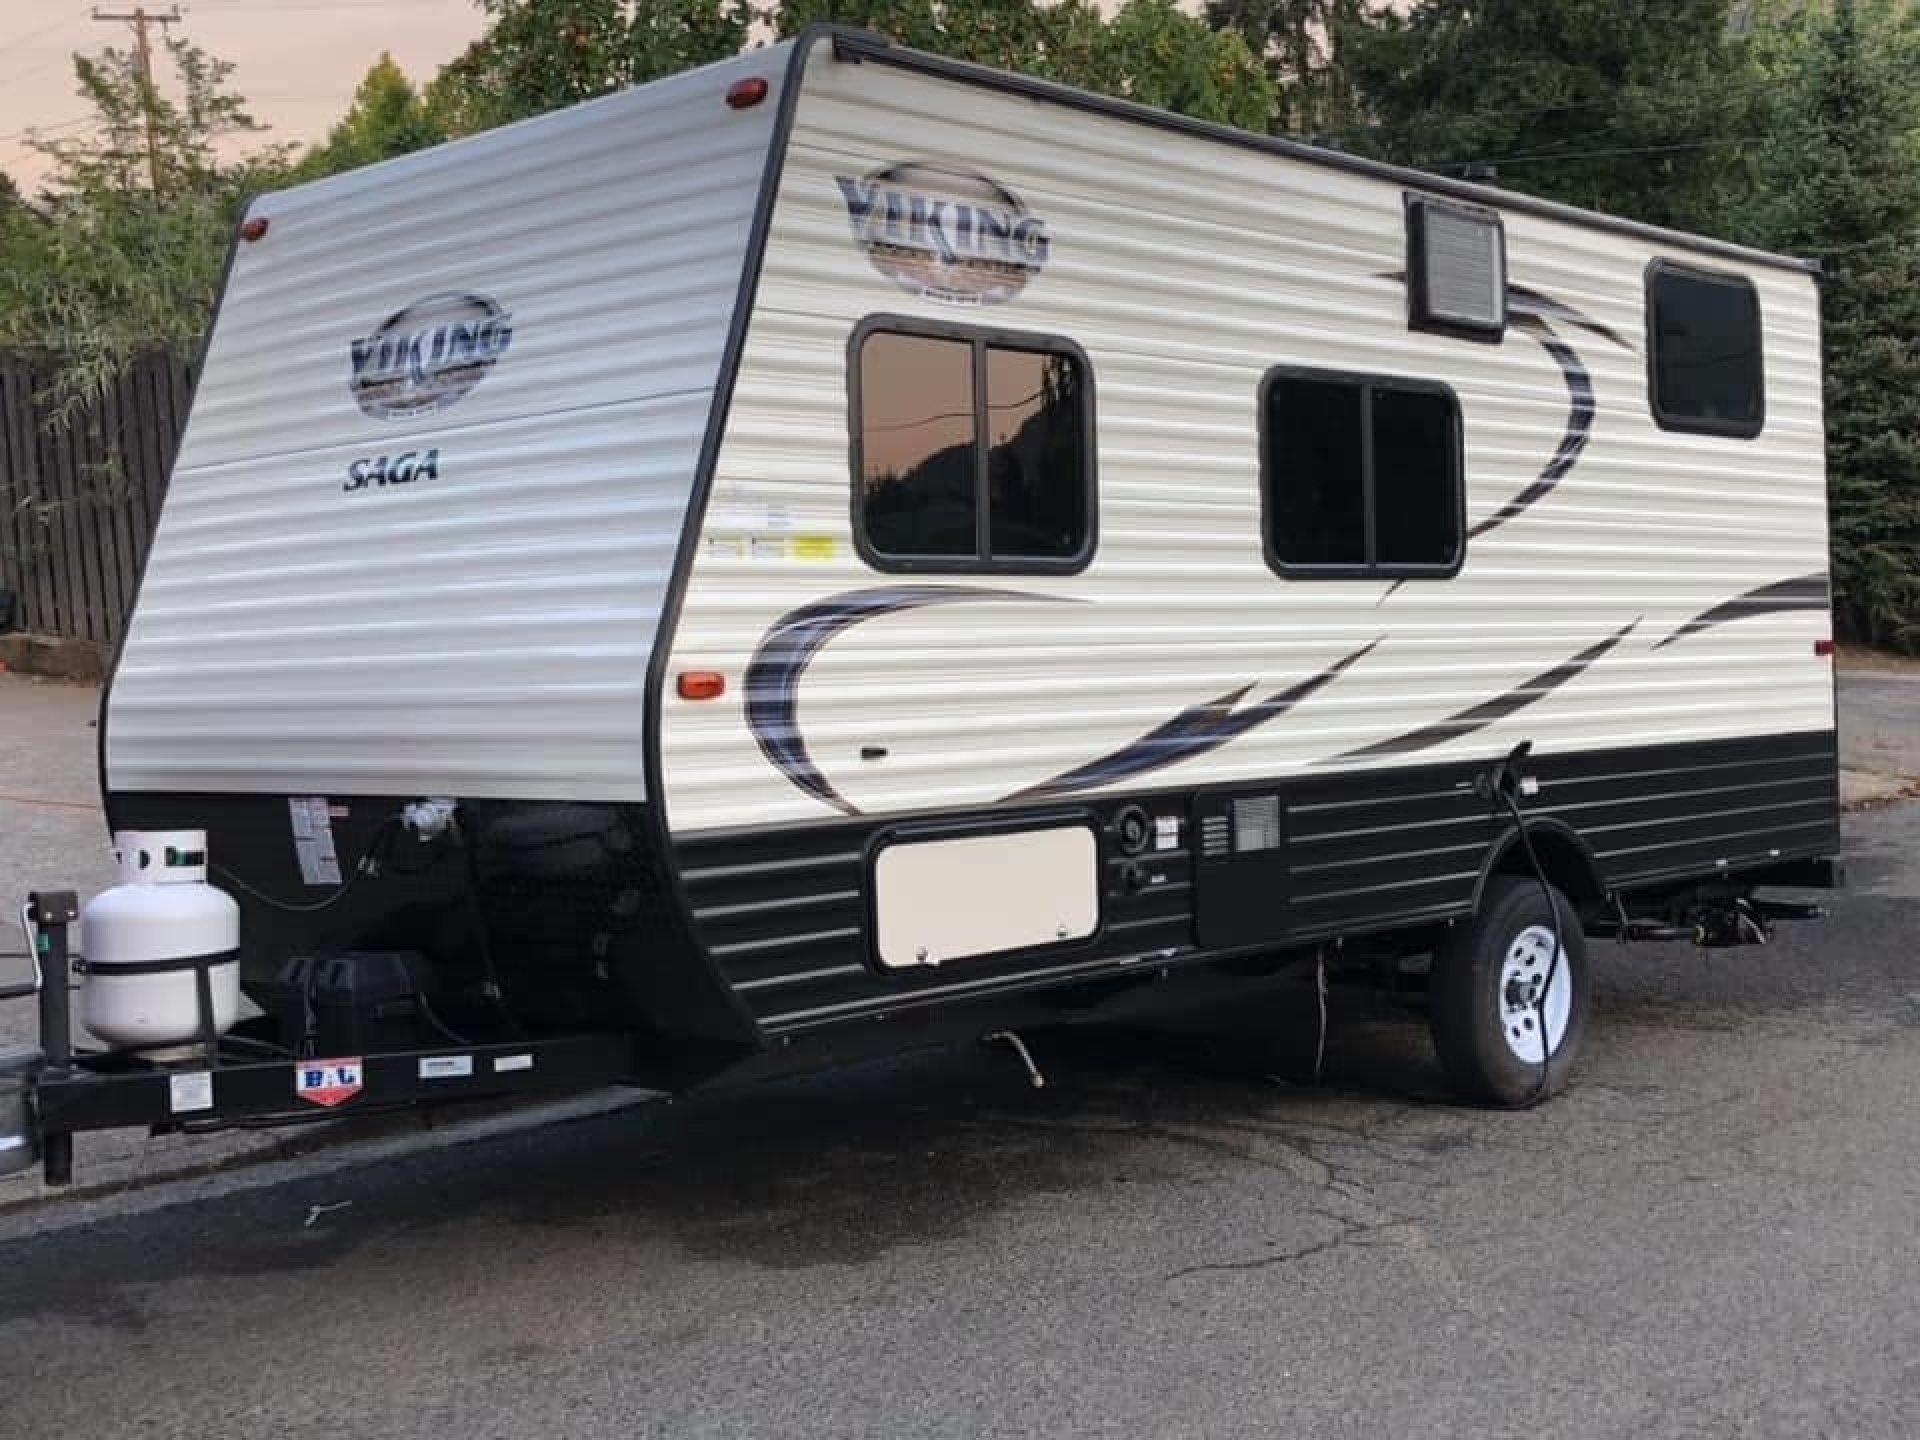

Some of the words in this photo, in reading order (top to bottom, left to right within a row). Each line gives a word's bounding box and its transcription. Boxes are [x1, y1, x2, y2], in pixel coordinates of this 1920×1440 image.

[833, 174, 1050, 267] VIKING
[351, 312, 513, 386] VIKING
[343, 448, 439, 492] SAGA
